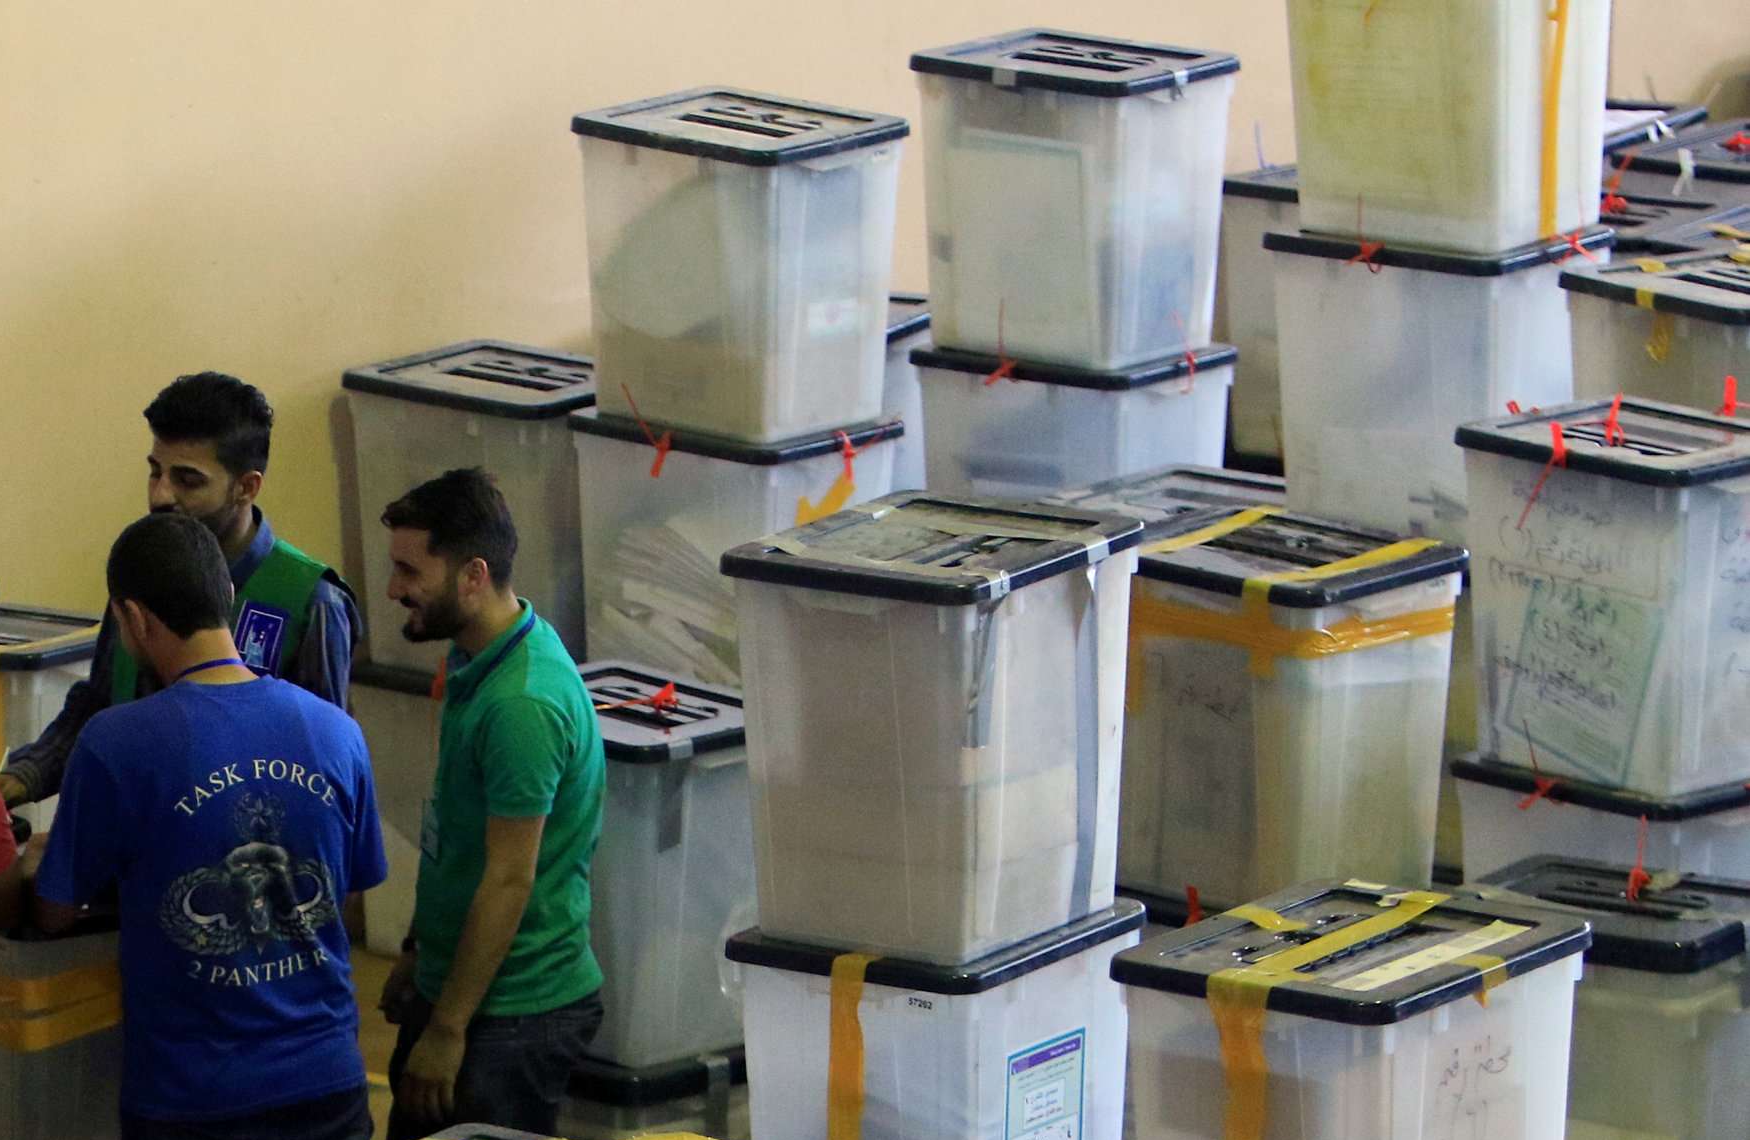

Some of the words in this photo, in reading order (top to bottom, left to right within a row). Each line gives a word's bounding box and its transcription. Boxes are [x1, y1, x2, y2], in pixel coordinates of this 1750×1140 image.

[174, 763, 244, 817] TASK
[253, 759, 337, 808] FORCE
[187, 959, 202, 980] 2
[209, 950, 329, 986] PANTHER
